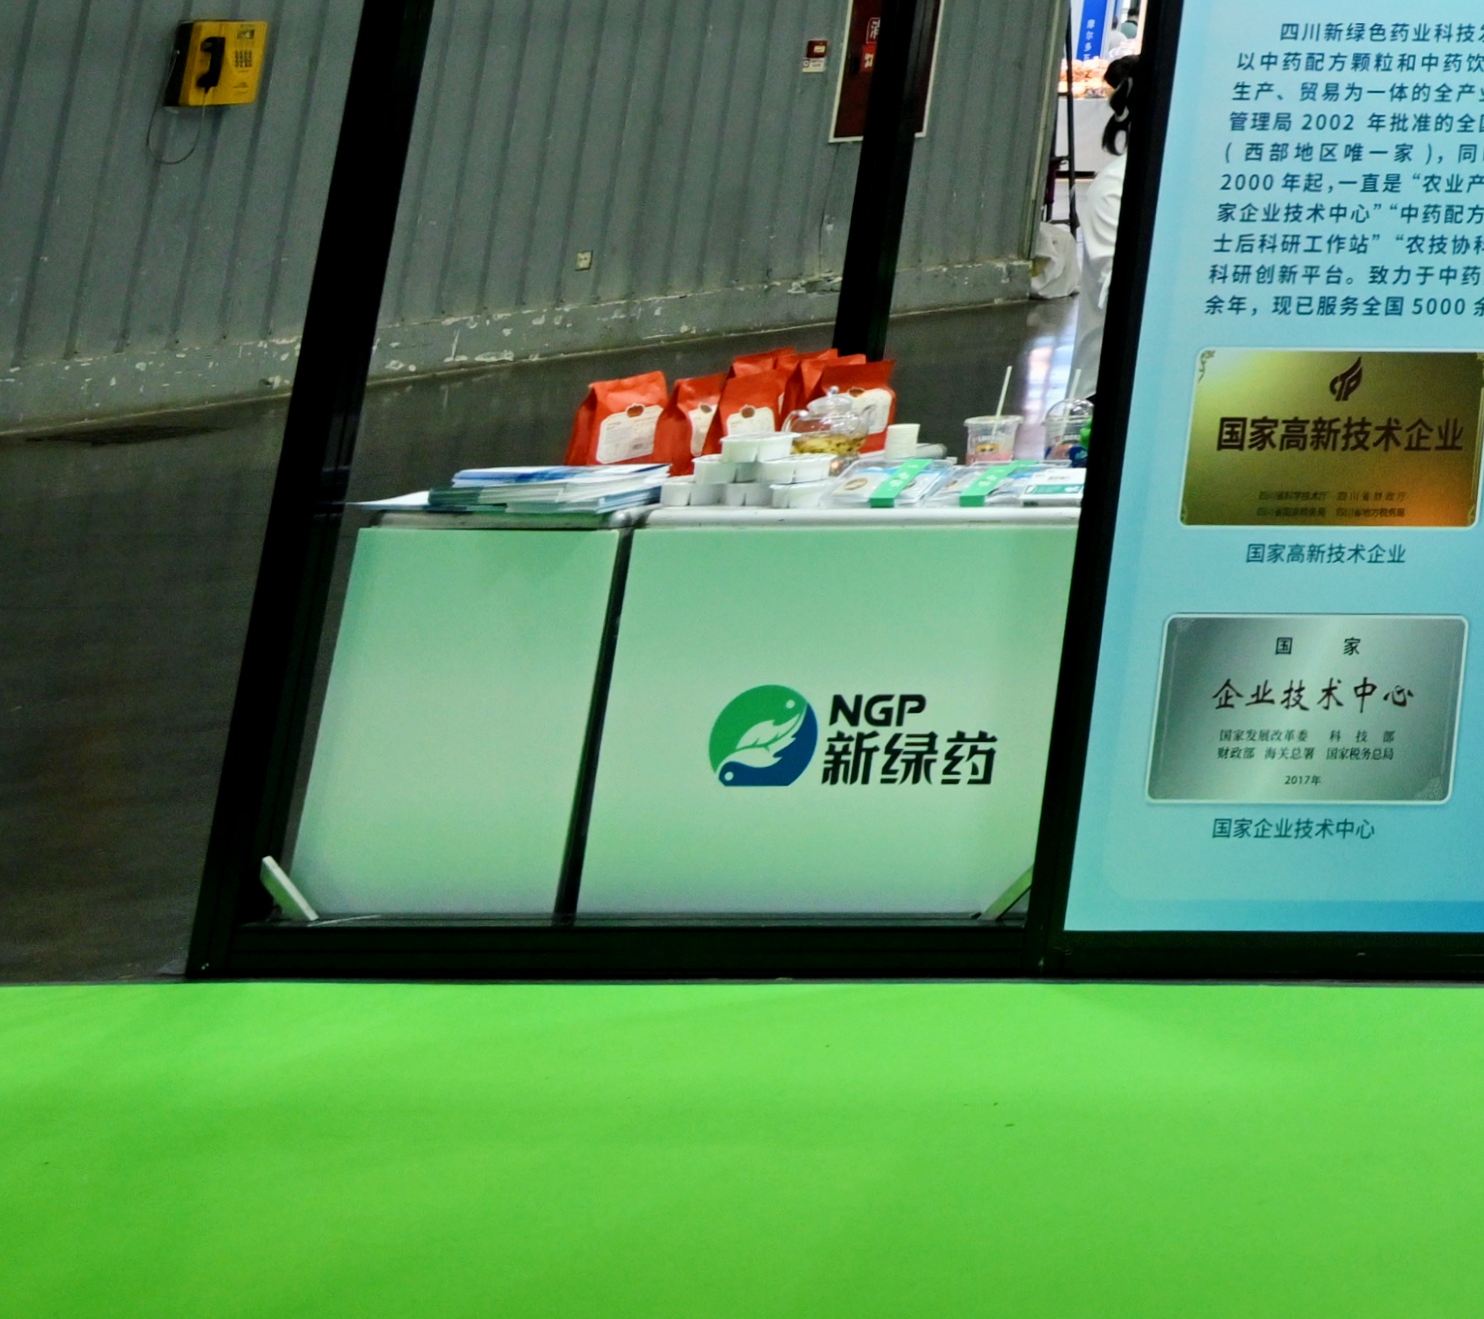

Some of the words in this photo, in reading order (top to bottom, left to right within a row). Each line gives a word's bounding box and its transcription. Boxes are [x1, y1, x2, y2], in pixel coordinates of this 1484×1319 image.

[1217, 416, 1464, 452] 国家高新技术企业
[1246, 543, 1406, 565] 国家高新技术企业
[829, 694, 927, 727] NGP
[1212, 676, 1414, 713] 企业技术中心
[821, 730, 999, 786] 新绿药
[1284, 774, 1322, 786] 2017年
[1212, 818, 1375, 840] 国家企业技术中心
